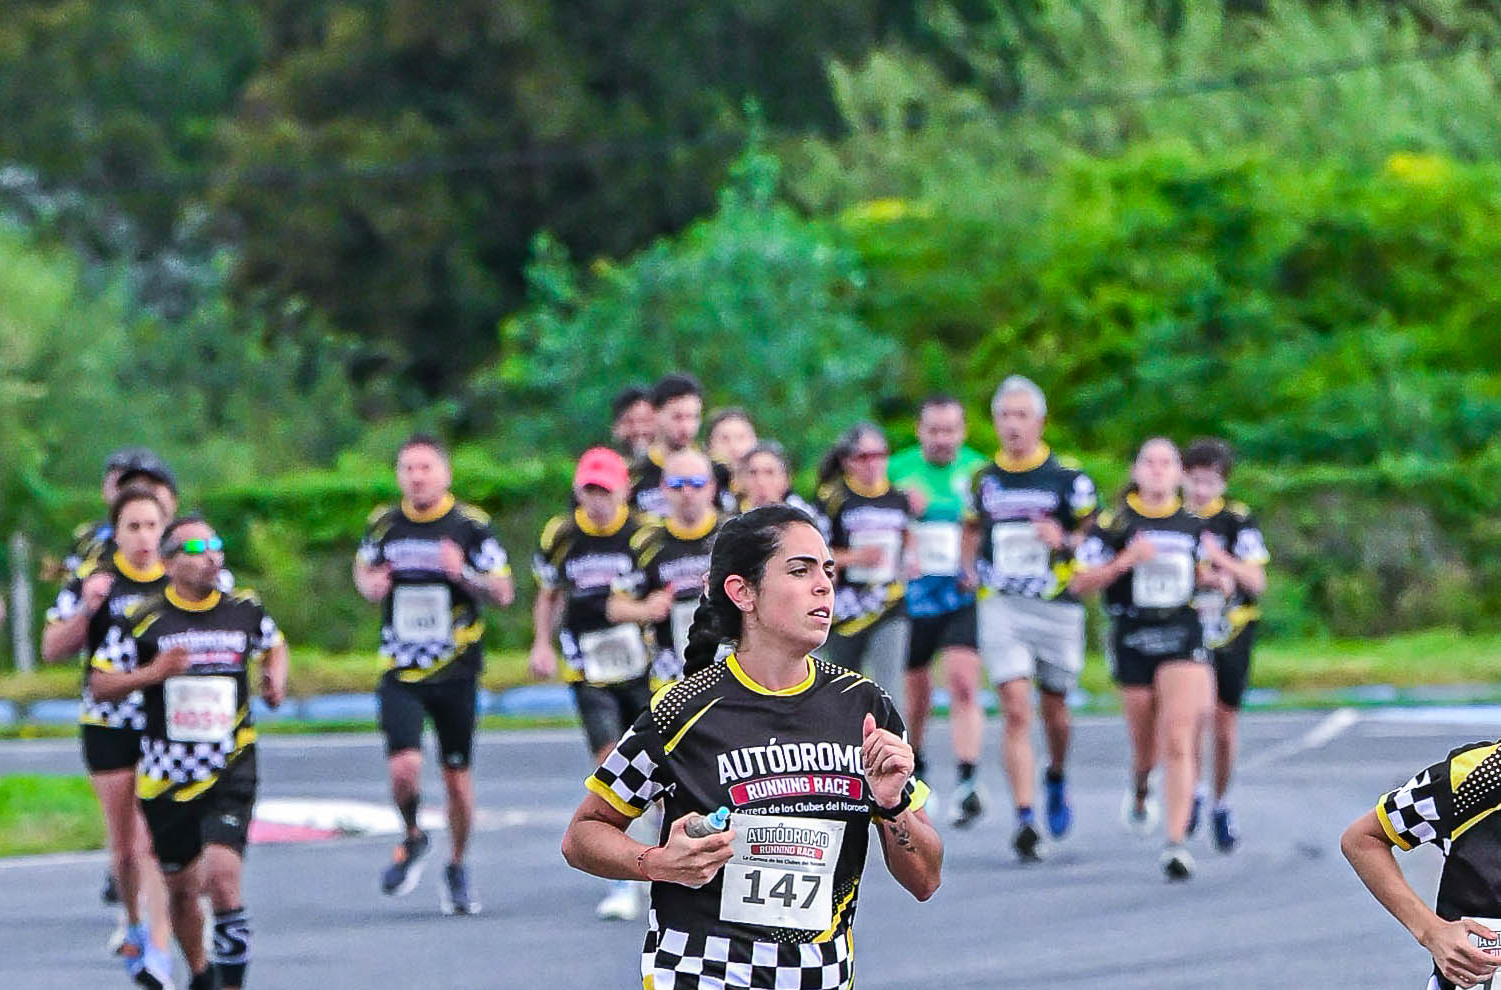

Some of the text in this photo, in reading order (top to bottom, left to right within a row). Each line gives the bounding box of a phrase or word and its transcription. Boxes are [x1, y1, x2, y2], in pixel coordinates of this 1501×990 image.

[745, 776, 850, 801] RUNNING RACE
[768, 804, 780, 814] de
[781, 803, 794, 813] los
[795, 802, 824, 812] Clubes
[826, 801, 839, 811] del
[747, 823, 830, 848] AUTÓDROMO
[742, 869, 822, 910] 147
